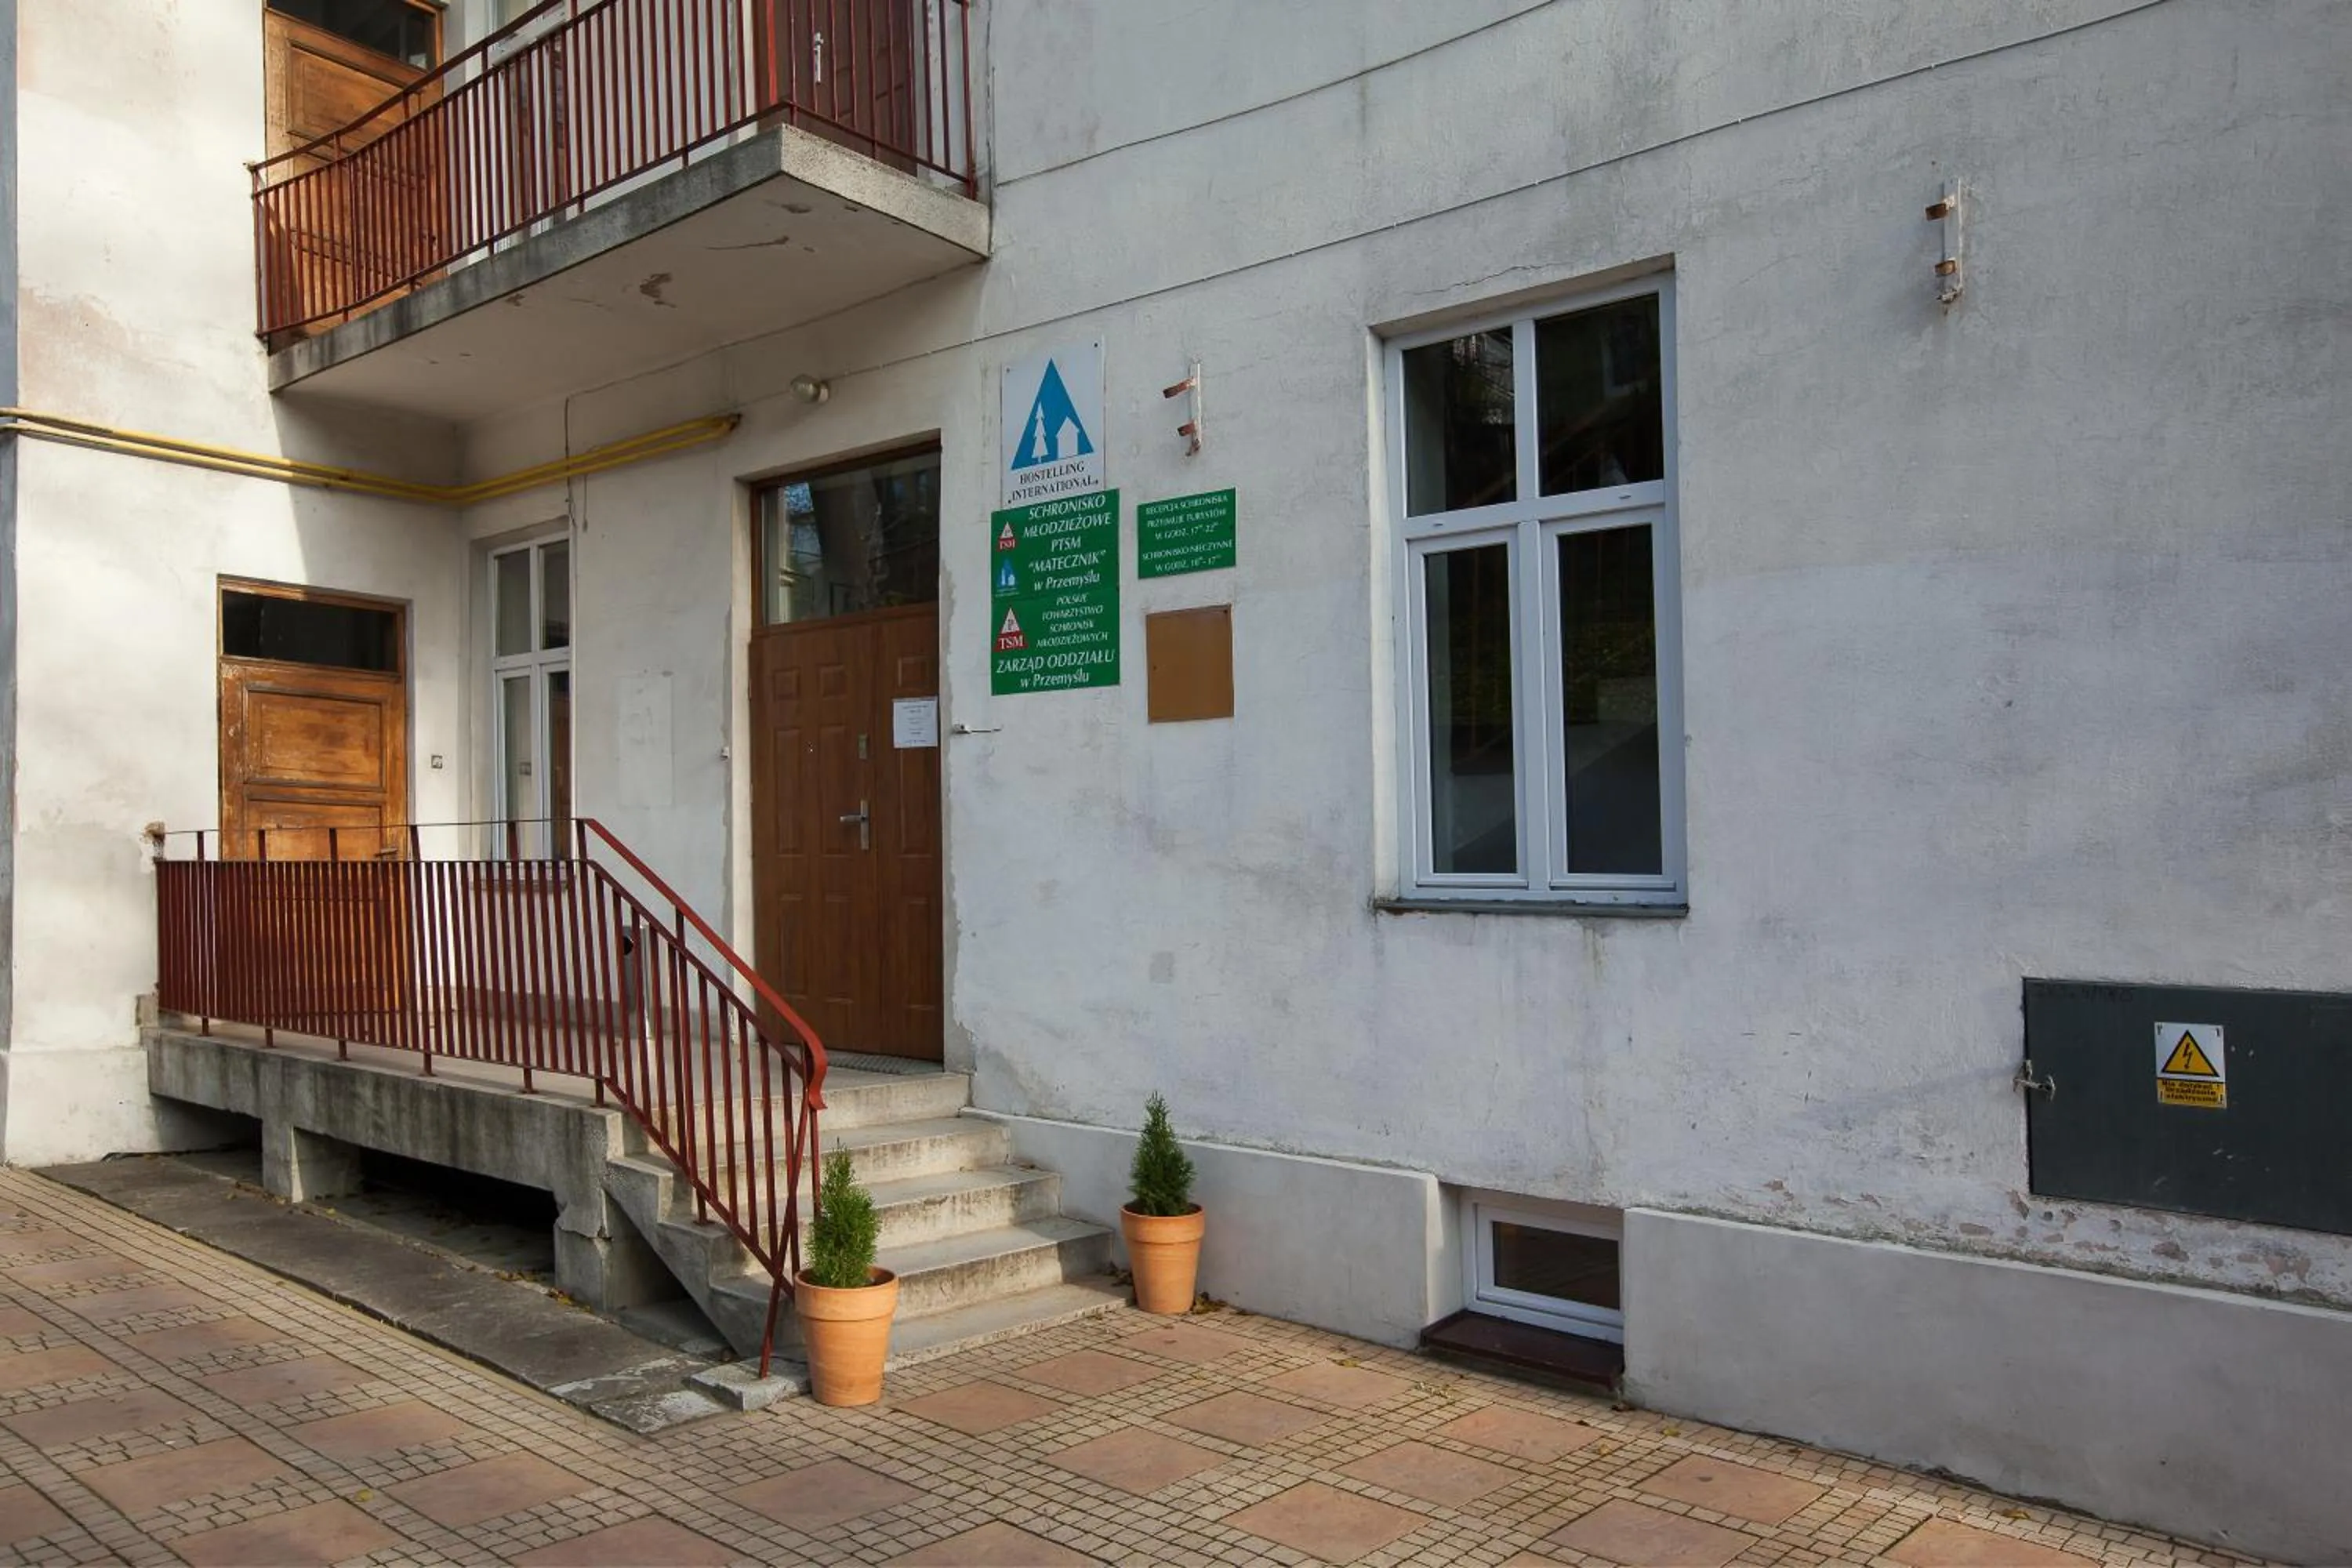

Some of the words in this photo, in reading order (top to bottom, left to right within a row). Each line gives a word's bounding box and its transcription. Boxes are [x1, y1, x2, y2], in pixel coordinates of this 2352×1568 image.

[1020, 461, 1084, 484] HOSTELLING
[1012, 475, 1091, 500] INTERNATIONAL
[1029, 495, 1106, 520] SCHRONISKO
[1022, 511, 1112, 539] MŁODZIEŻOWE
[1051, 535, 1081, 552] PTSM
[1034, 581, 1044, 591] w
[1046, 569, 1100, 590] Przemyślu
[1042, 604, 1104, 621] TOWARZYSTWO
[1000, 636, 1024, 650] TSM
[996, 655, 1044, 673] ZARZĄD
[1047, 648, 1115, 669] ODDZIAŁU
[1020, 677, 1031, 688] w
[1033, 667, 1089, 687] Przemyślu
